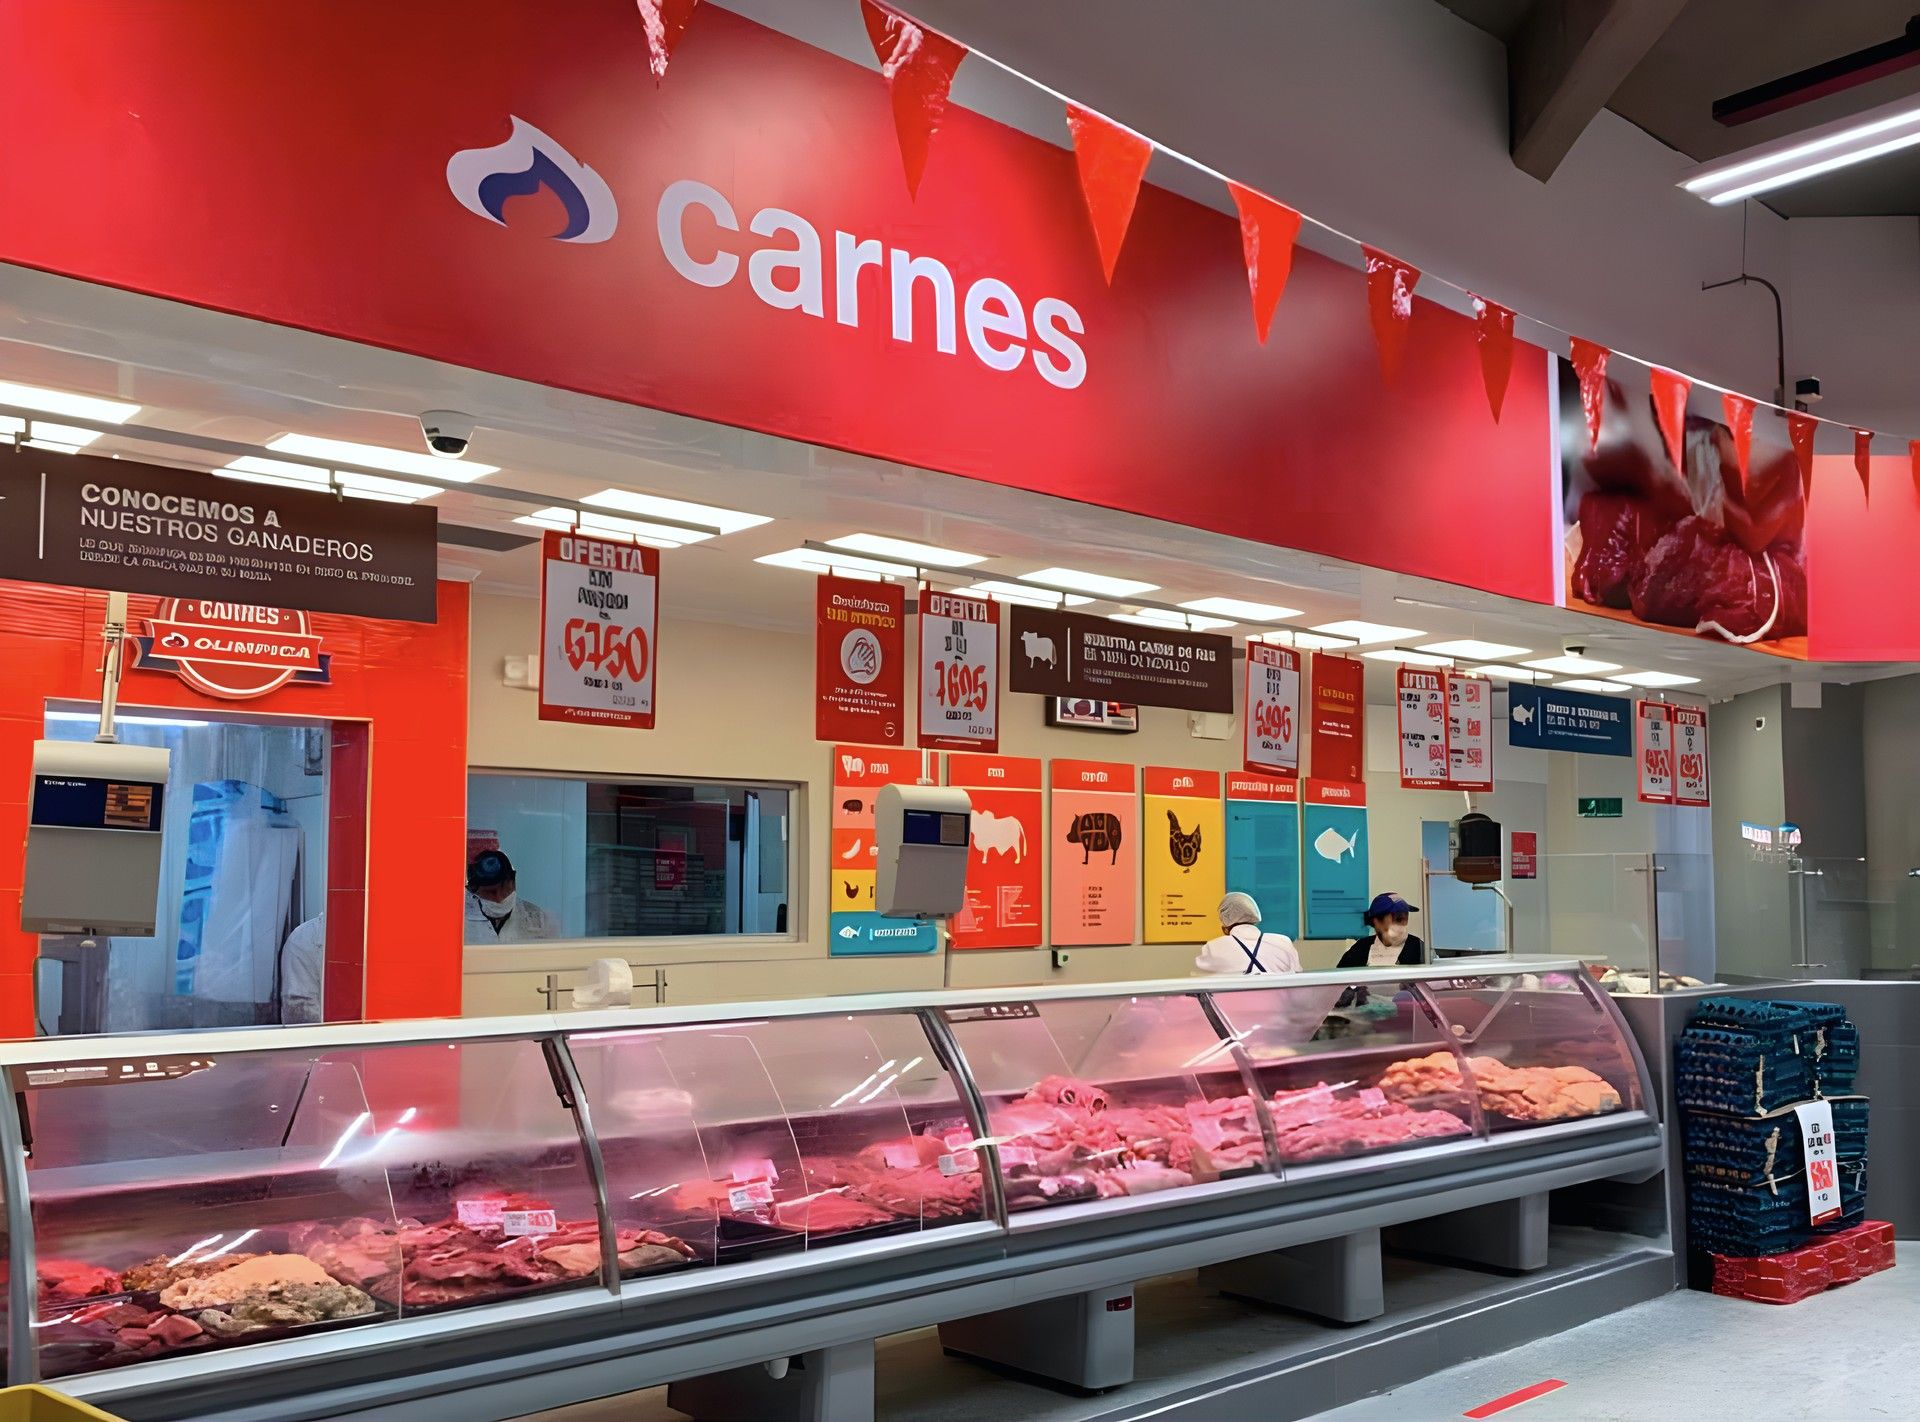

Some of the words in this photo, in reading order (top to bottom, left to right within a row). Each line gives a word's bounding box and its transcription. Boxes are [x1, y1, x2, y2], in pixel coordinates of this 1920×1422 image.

[656, 179, 1088, 390] carnes
[80, 483, 255, 526] CONOCEMOS
[263, 510, 282, 529] A
[80, 506, 219, 543] NUESTROS
[227, 526, 375, 563] GANADEROS
[559, 537, 645, 574] OFERTA
